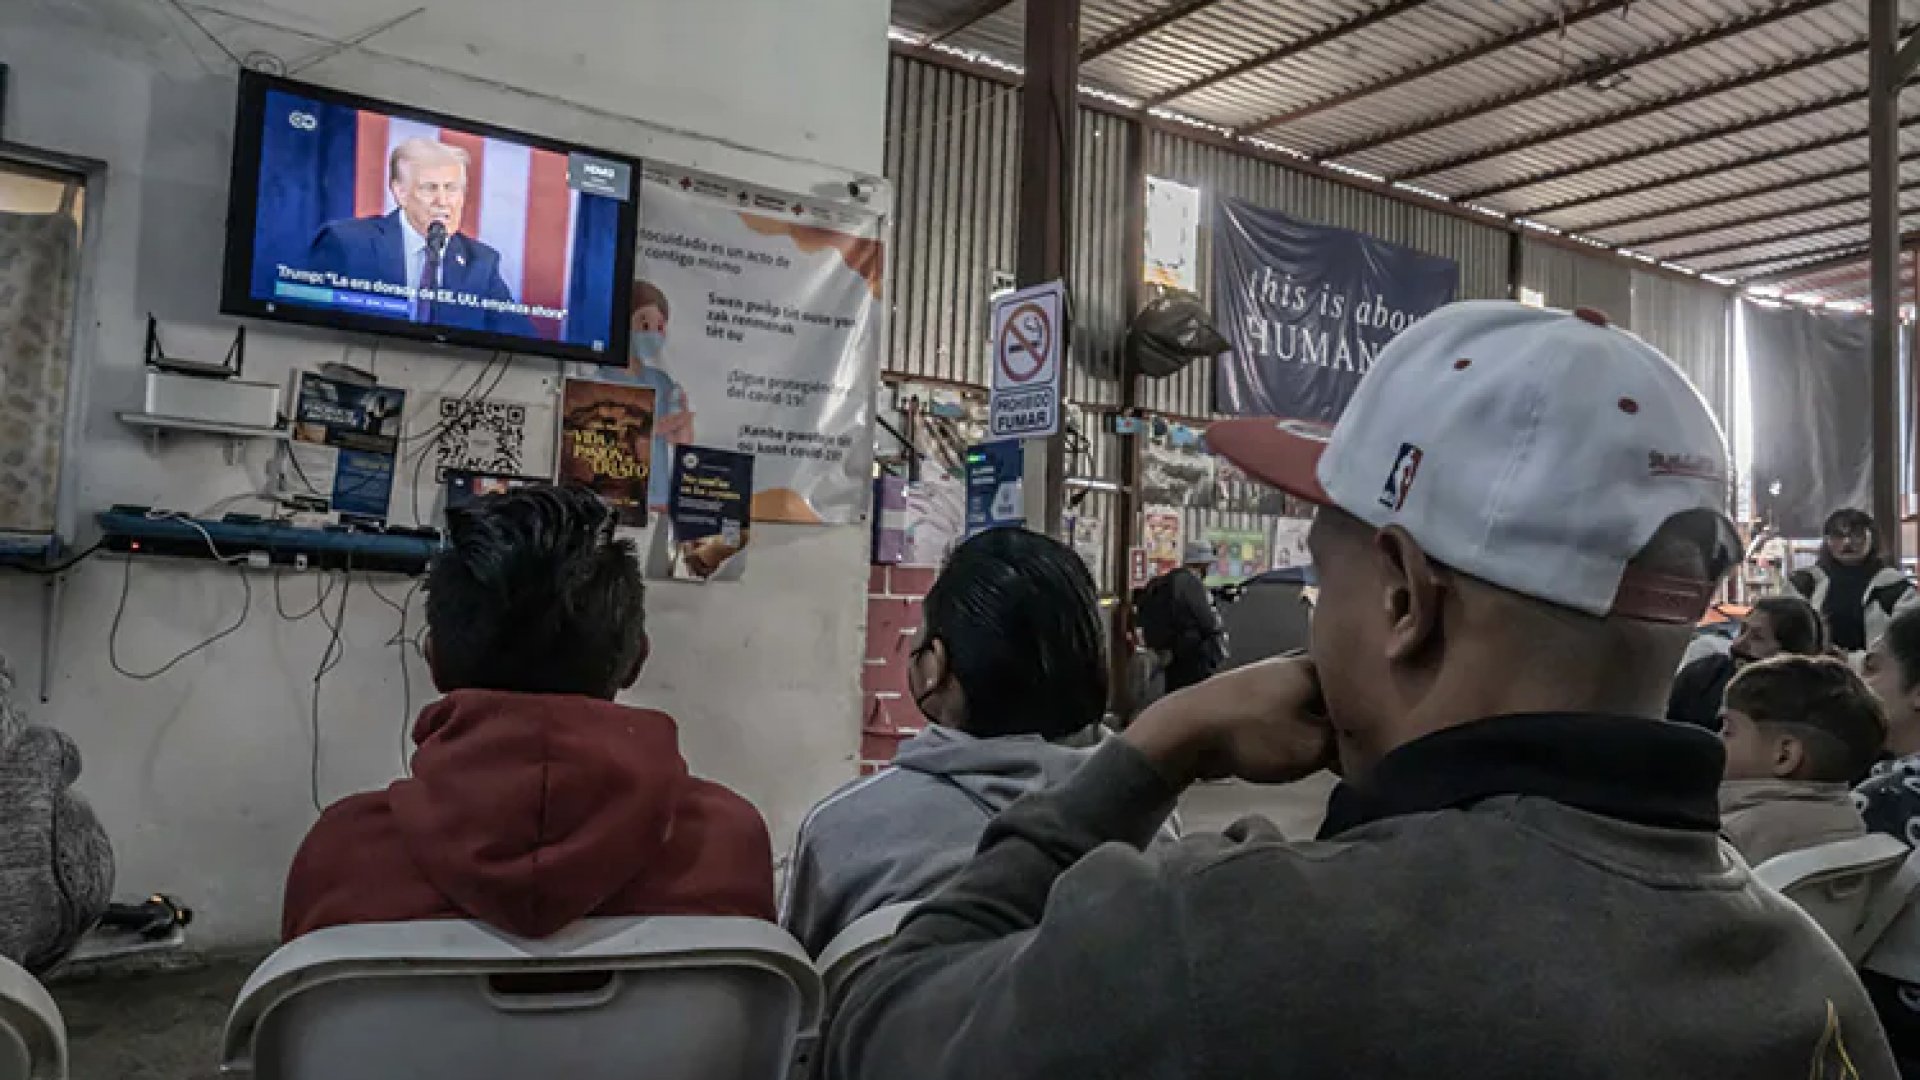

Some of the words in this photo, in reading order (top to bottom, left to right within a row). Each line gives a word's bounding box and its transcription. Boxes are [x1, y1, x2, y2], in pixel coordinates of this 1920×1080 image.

[644, 247, 694, 267] contigo
[698, 257, 741, 275] mismo
[711, 243, 725, 255] es
[727, 247, 743, 258] un
[747, 250, 773, 265] acto
[775, 255, 791, 269] de
[708, 292, 743, 308] Swen
[1320, 283, 1345, 318] is
[997, 410, 1048, 431] FUMAR
